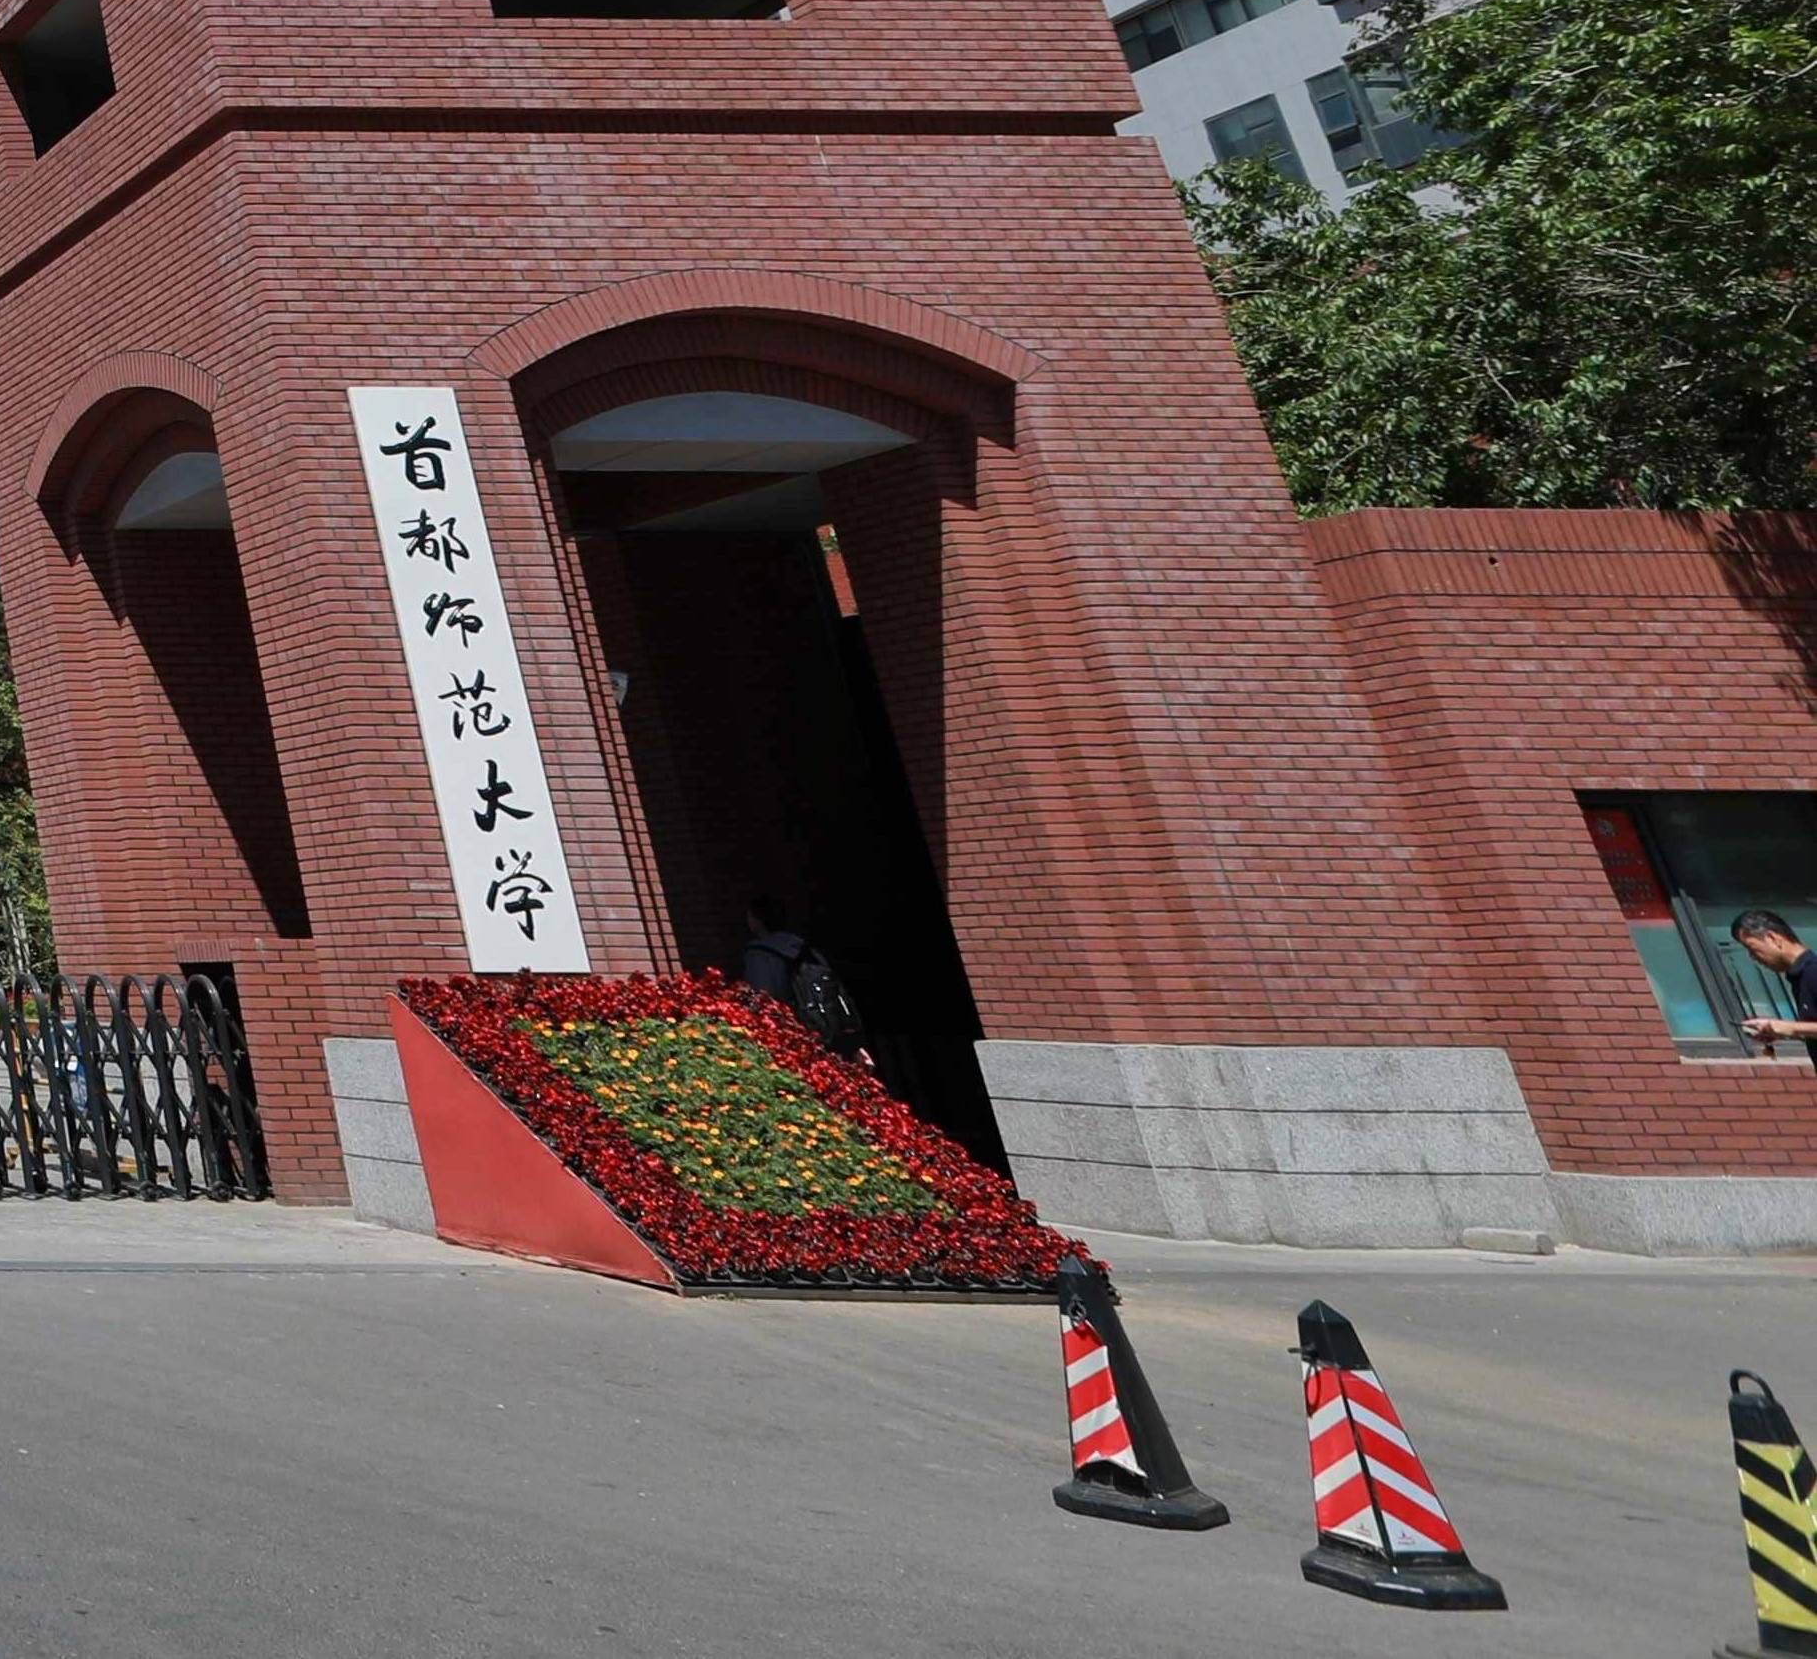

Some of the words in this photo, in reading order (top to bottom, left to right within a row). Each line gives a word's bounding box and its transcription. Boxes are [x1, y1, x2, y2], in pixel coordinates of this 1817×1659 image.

[378, 416, 553, 941] 首都师范大学
